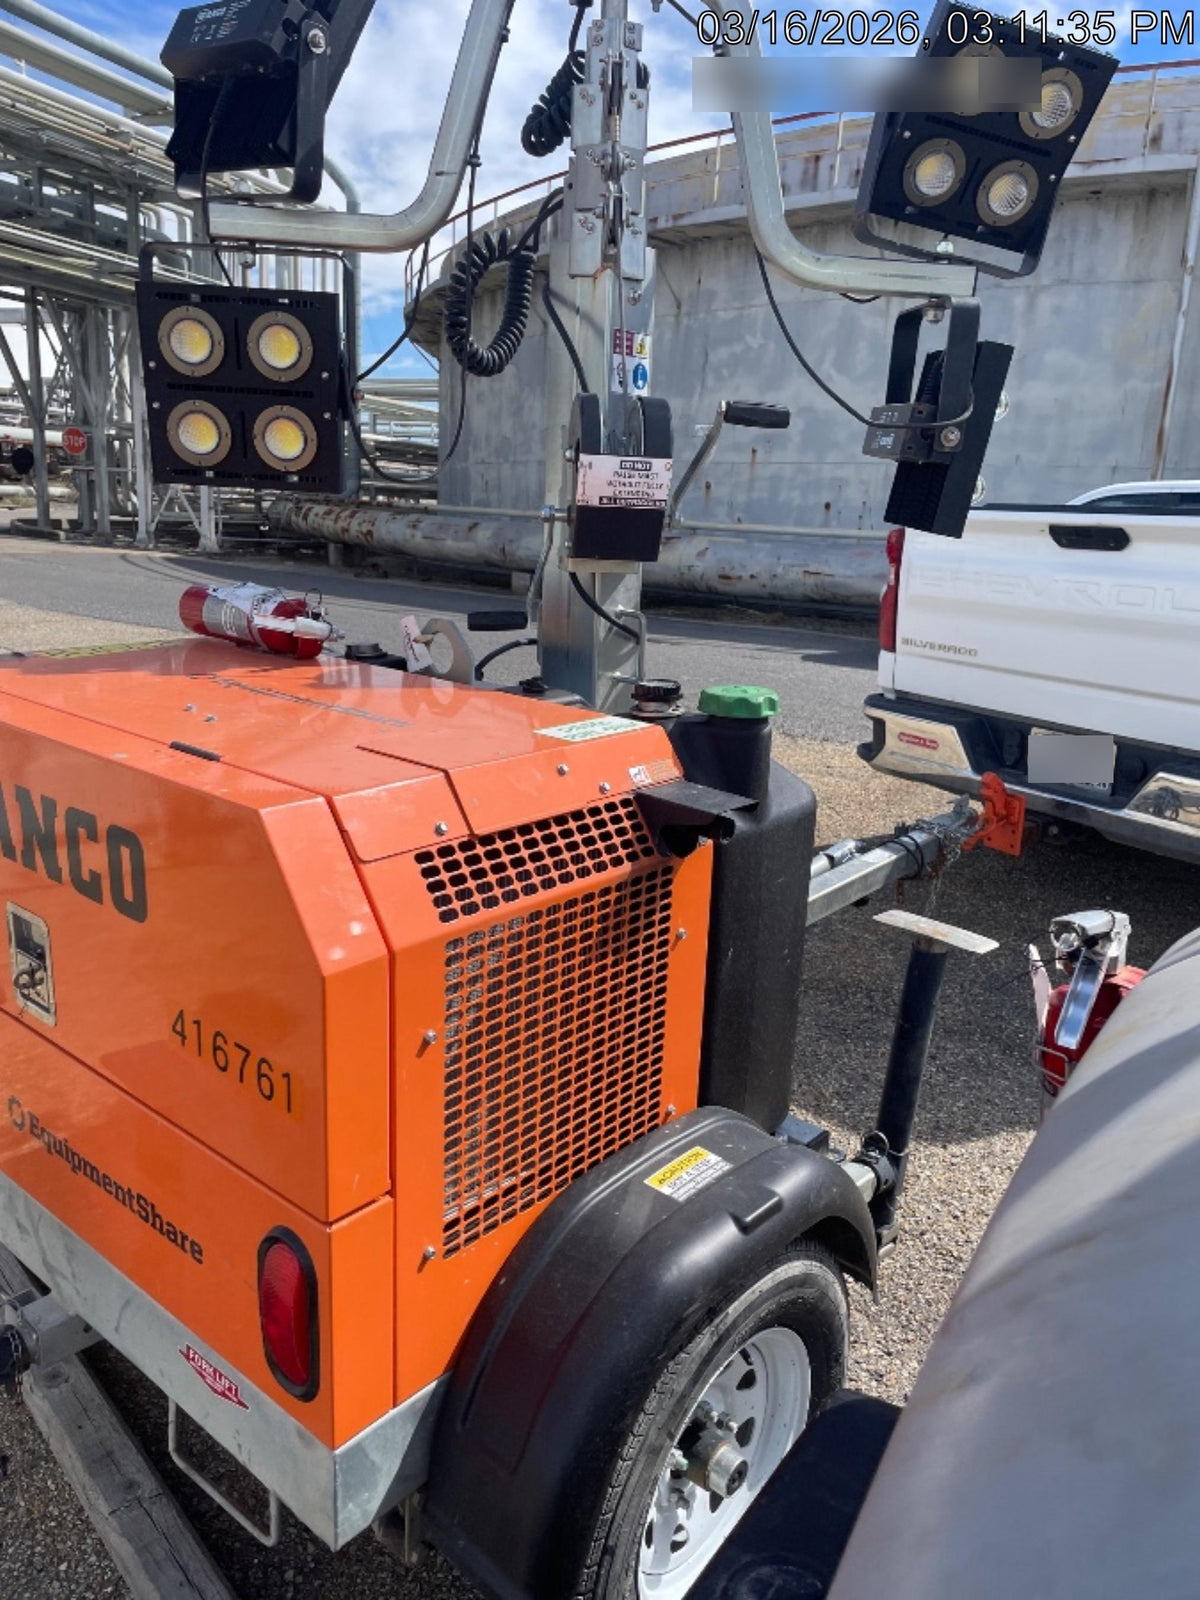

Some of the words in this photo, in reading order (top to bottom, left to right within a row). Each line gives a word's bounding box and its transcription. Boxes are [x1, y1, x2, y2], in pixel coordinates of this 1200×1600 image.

[64, 435, 85, 447] STOP
[635, 461, 651, 470] NOT
[901, 637, 978, 657] SILVERADO
[172, 1009, 291, 1113] 416761
[28, 1110, 204, 1264] EquipmentShare
[189, 1348, 215, 1377] FORK
[216, 1371, 237, 1394] LIFT
